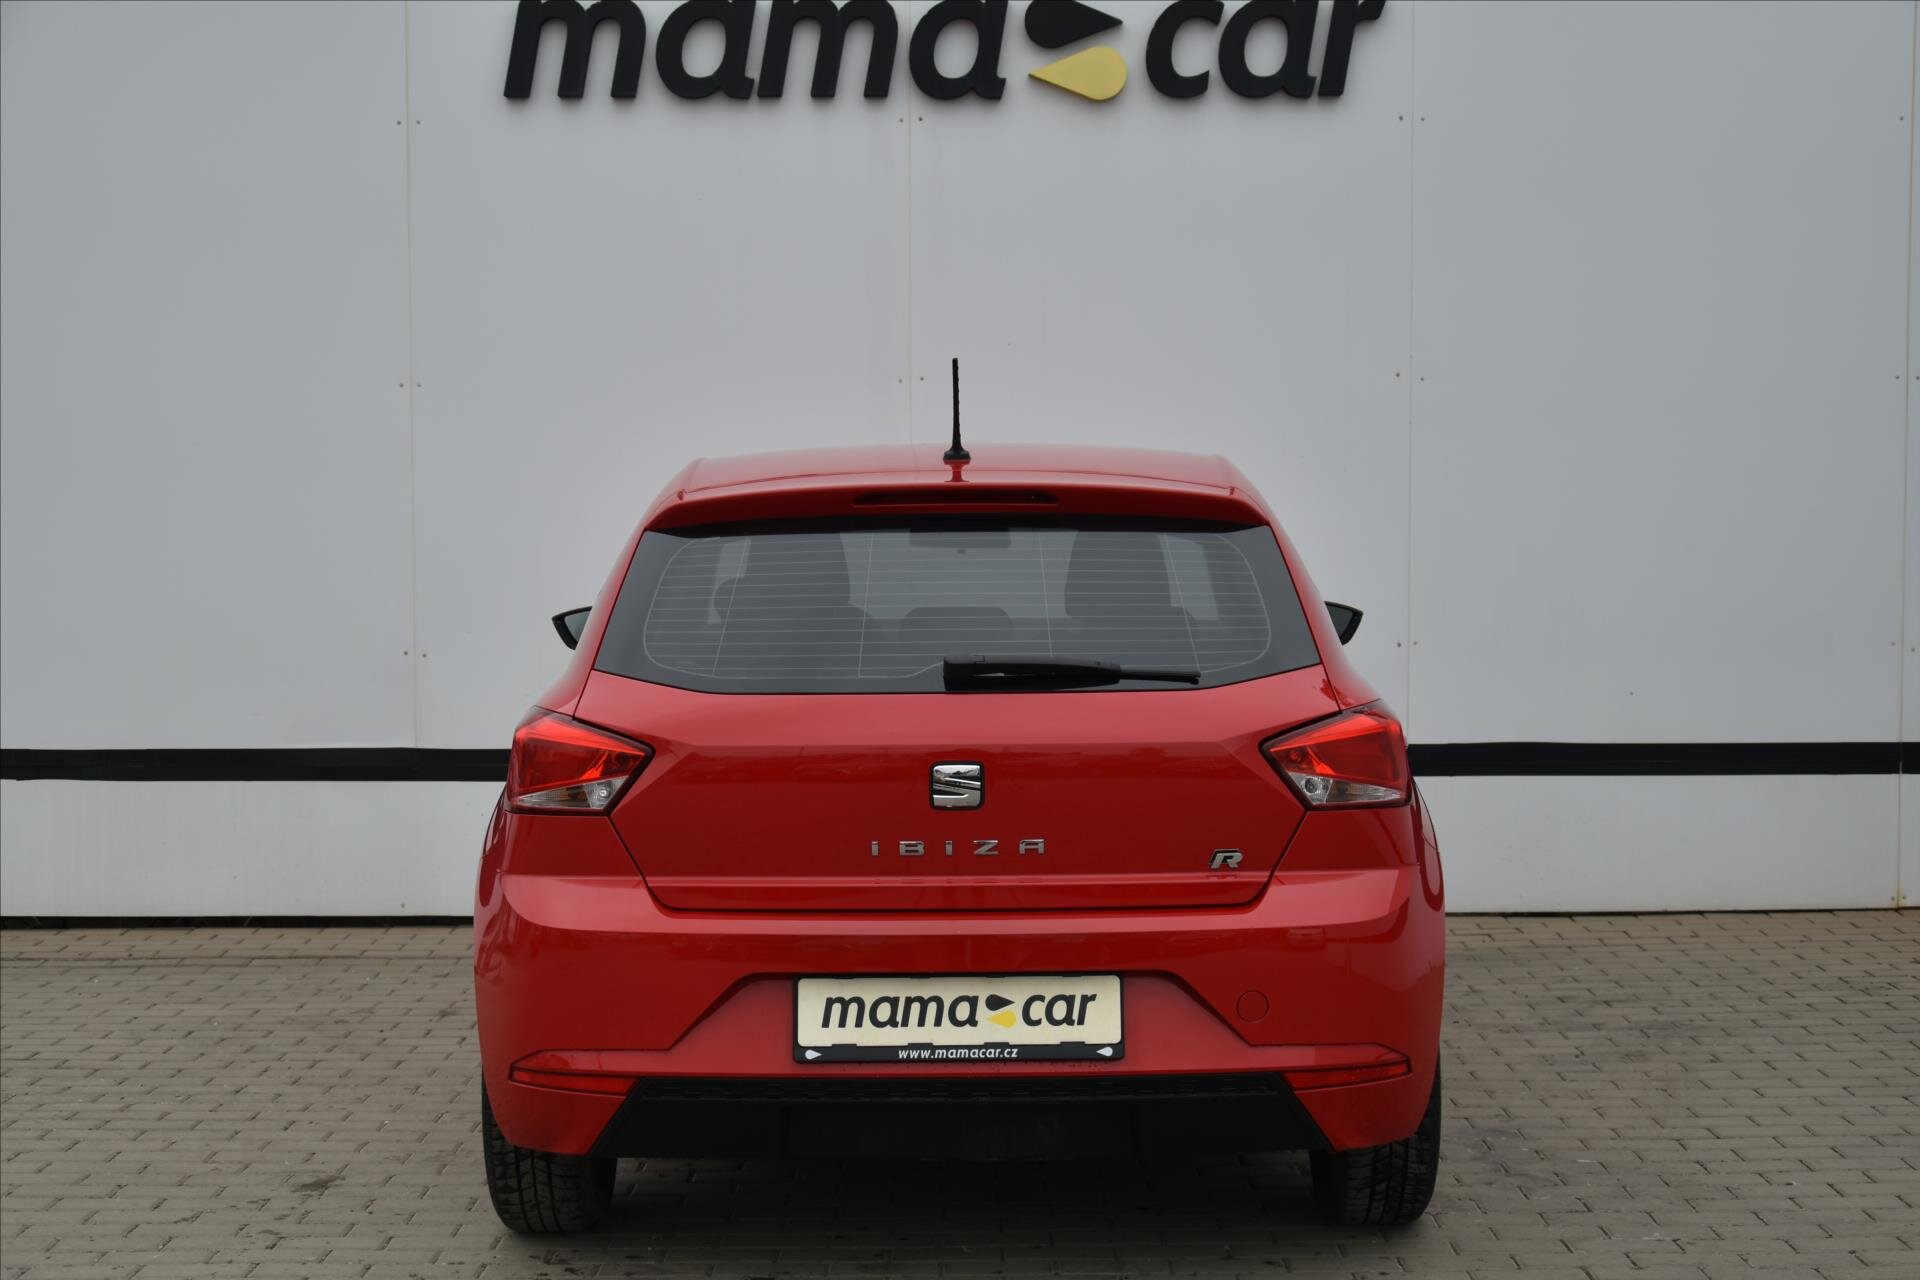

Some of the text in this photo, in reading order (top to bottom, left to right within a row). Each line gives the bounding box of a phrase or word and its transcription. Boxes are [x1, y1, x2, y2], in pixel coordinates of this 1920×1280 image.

[504, 0, 1386, 98] mama car
[821, 993, 1097, 1028] mama car
[898, 1046, 1018, 1059] www.mamacar.cz
